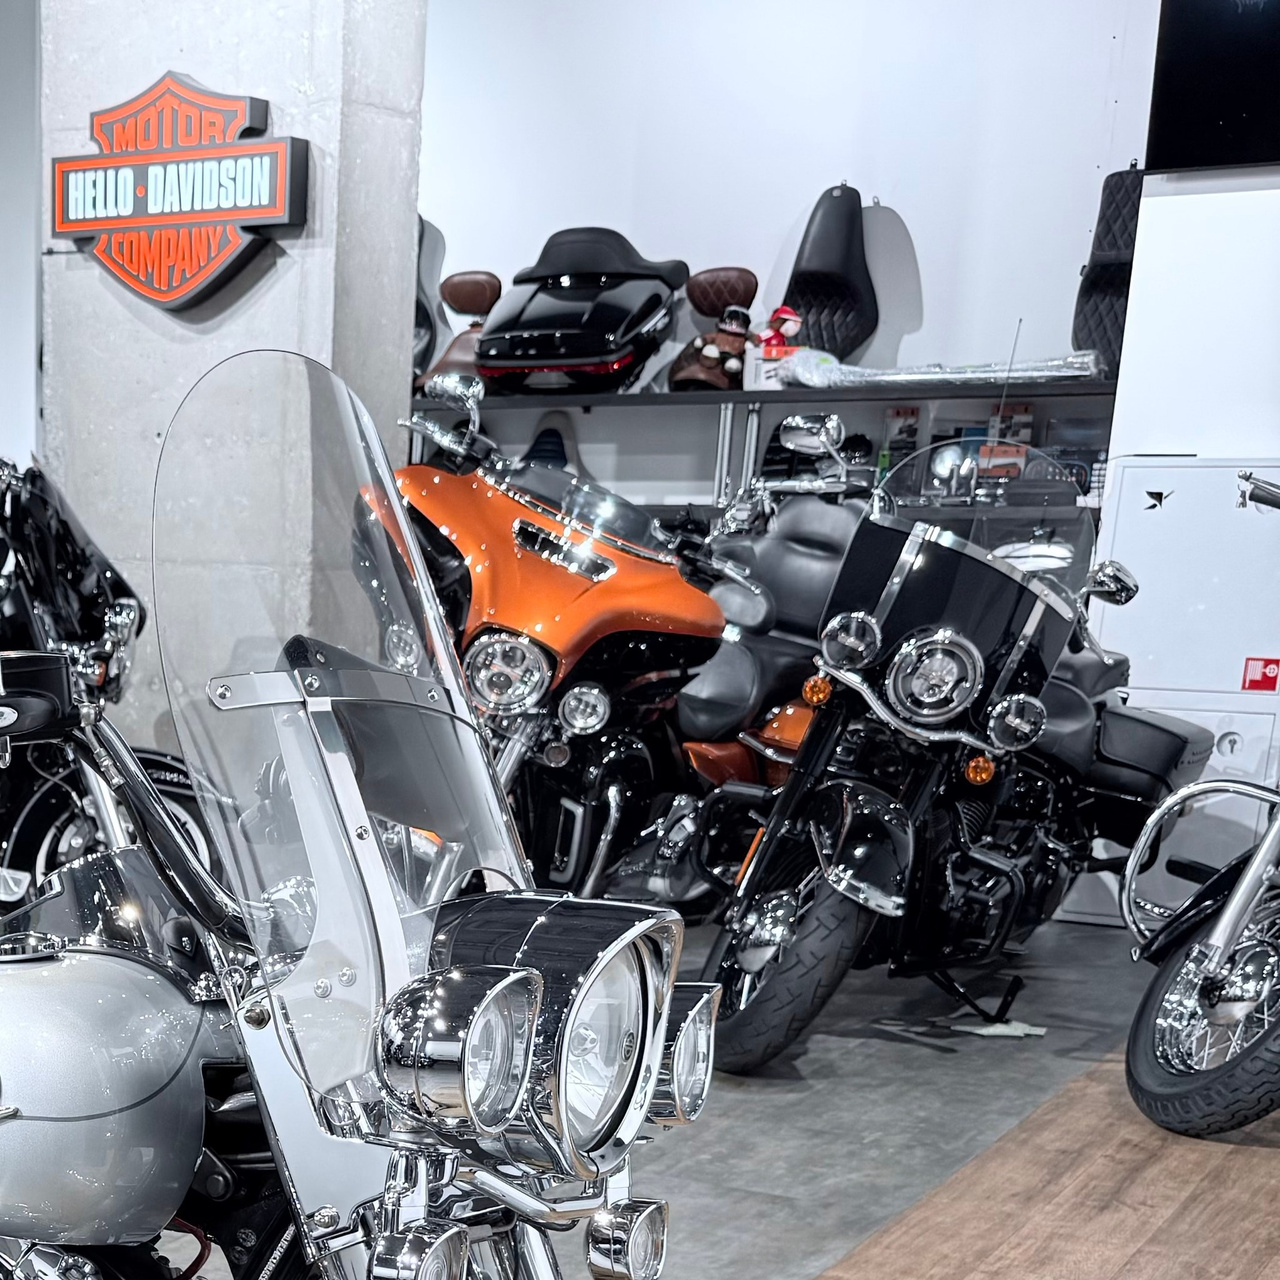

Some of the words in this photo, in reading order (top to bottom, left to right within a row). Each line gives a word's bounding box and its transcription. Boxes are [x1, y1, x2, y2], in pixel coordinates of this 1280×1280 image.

[113, 93, 225, 153] MOTOR
[68, 166, 135, 220] HELLO
[147, 155, 271, 214] DAVIDSON
[111, 224, 224, 290] COMPANY
